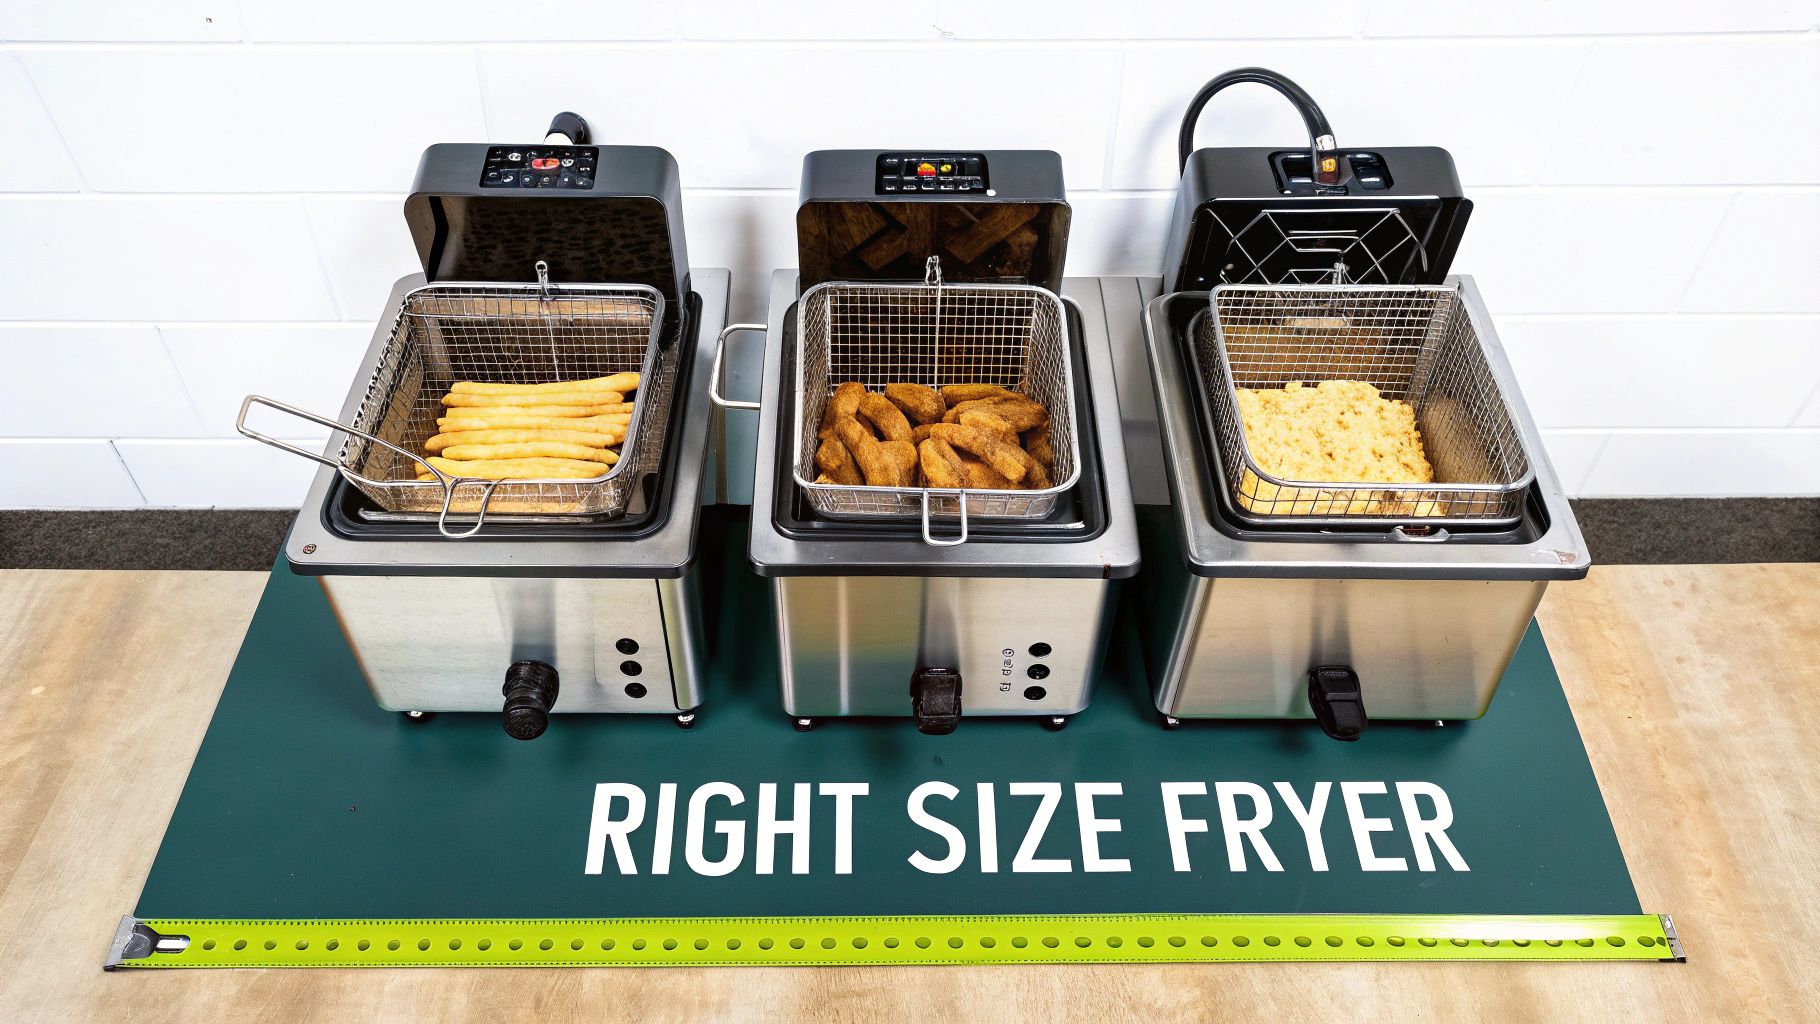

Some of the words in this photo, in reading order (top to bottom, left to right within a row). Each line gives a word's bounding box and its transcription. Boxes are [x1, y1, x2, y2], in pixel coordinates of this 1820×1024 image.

[584, 781, 870, 876] RIGHT
[907, 780, 1132, 874] SIZE
[1160, 781, 1471, 872] FRYER
